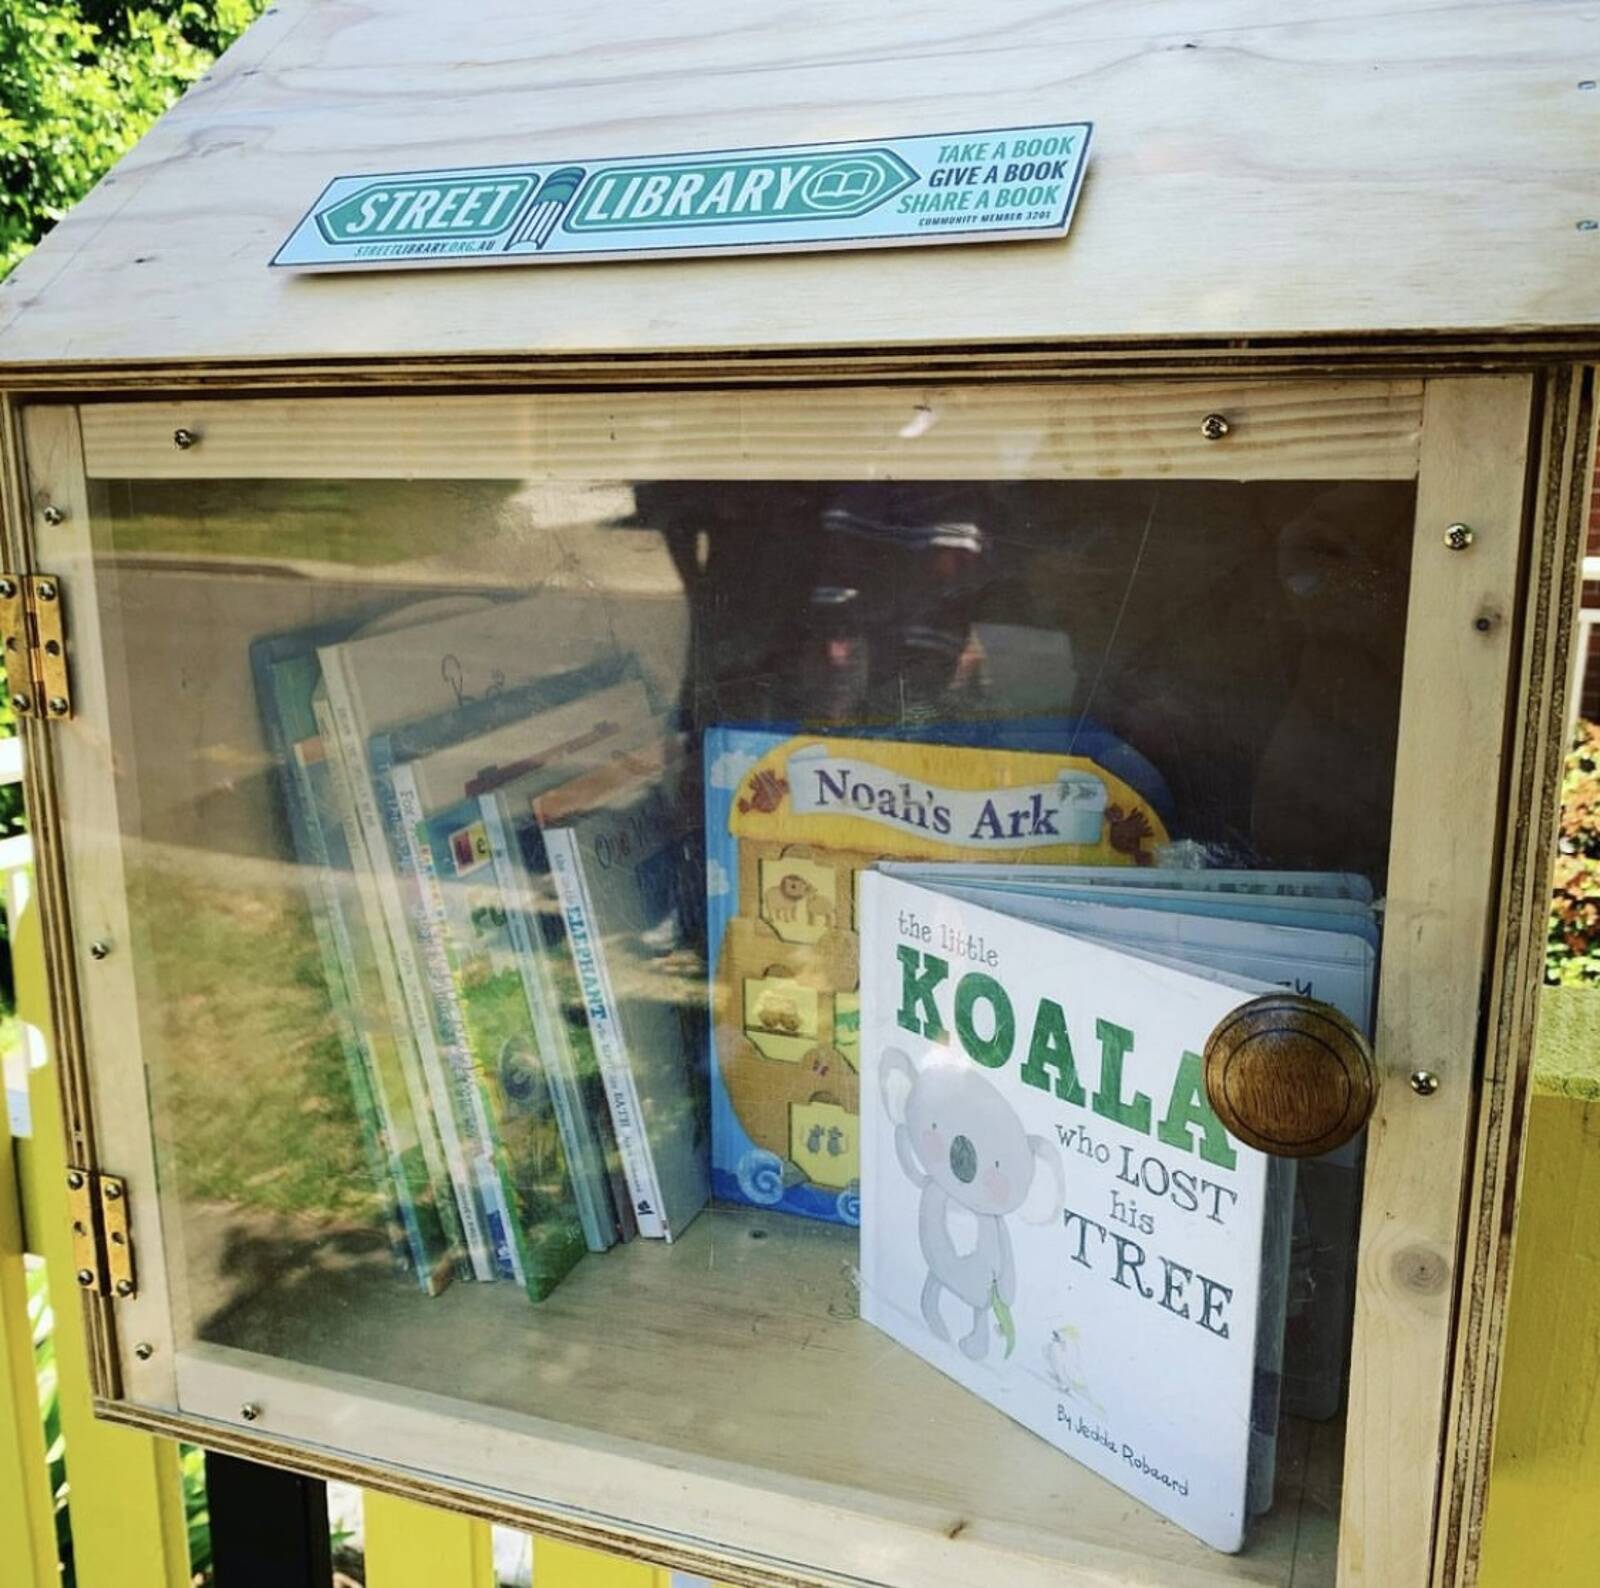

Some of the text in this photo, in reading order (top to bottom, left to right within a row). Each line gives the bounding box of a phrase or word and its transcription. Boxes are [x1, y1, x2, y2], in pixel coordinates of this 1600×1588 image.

[928, 159, 1068, 188] GIVE A BOOK
[937, 135, 1076, 164] TAKE A BOOK
[346, 166, 809, 234] STREET LIBRARY
[896, 184, 1060, 215] SHARE A BOOK
[918, 214, 978, 227] COMMUNITY
[981, 211, 1022, 223] MEMBER
[813, 769, 1060, 840] Noah's Ark
[566, 905, 608, 1020] ELEPHANT
[897, 909, 999, 967] the little
[895, 944, 1238, 1171] KOALA
[1054, 1122, 1238, 1226] who LOST
[1109, 1189, 1156, 1236] his
[1062, 1208, 1234, 1340] TREE
[1056, 1403, 1189, 1497] By Jedda Robaard
